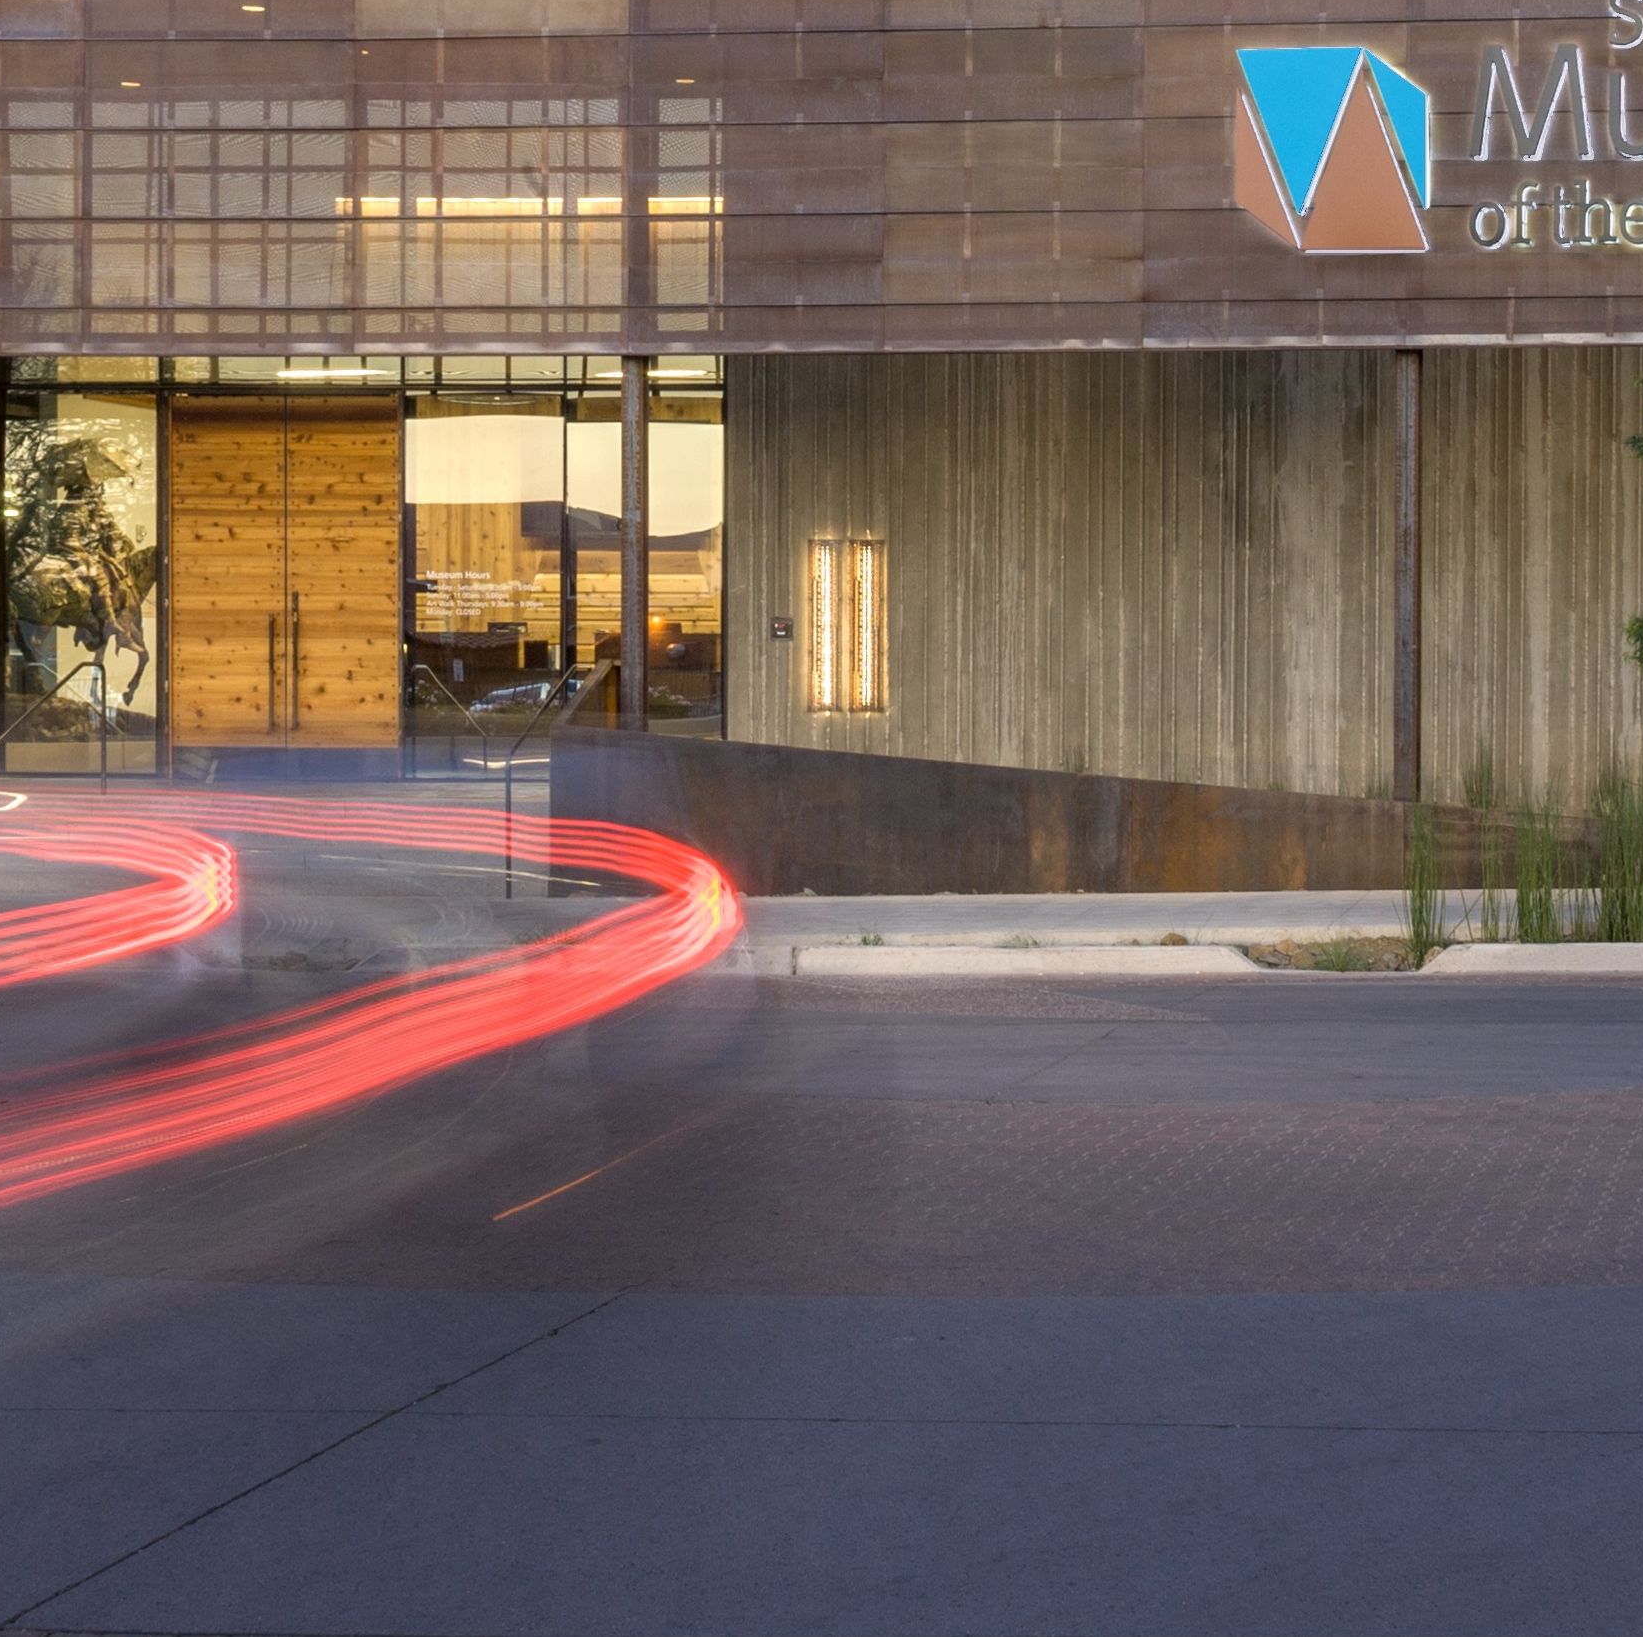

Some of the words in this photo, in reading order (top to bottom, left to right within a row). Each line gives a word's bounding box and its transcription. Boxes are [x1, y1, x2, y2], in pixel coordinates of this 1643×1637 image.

[1469, 180, 1540, 249] of
[426, 570, 463, 580] Museum
[464, 570, 491, 580] Hours
[454, 608, 482, 616] CLOSED
